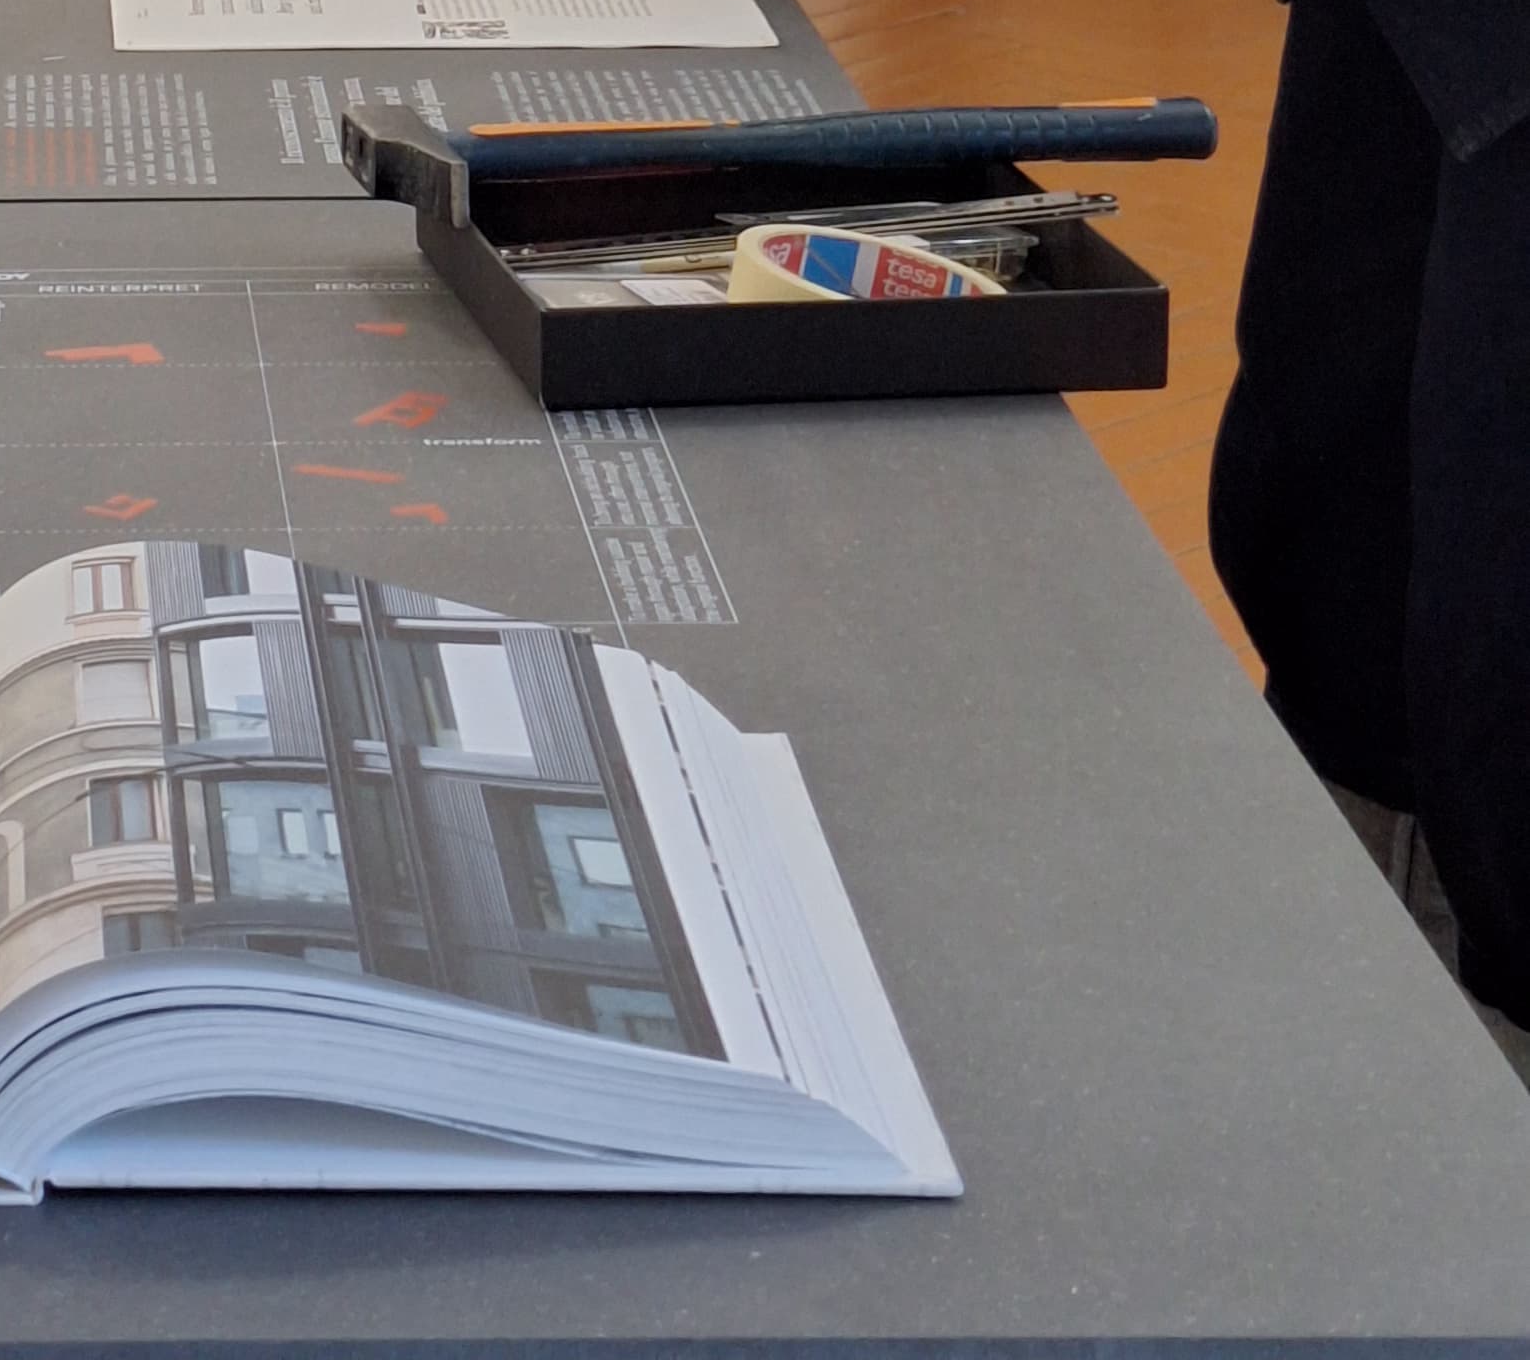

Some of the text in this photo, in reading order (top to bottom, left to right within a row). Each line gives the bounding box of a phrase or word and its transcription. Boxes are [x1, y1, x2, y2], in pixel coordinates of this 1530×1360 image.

[886, 257, 938, 289] tesa
[37, 282, 204, 294] REINTERPRET
[423, 437, 542, 446] transform
